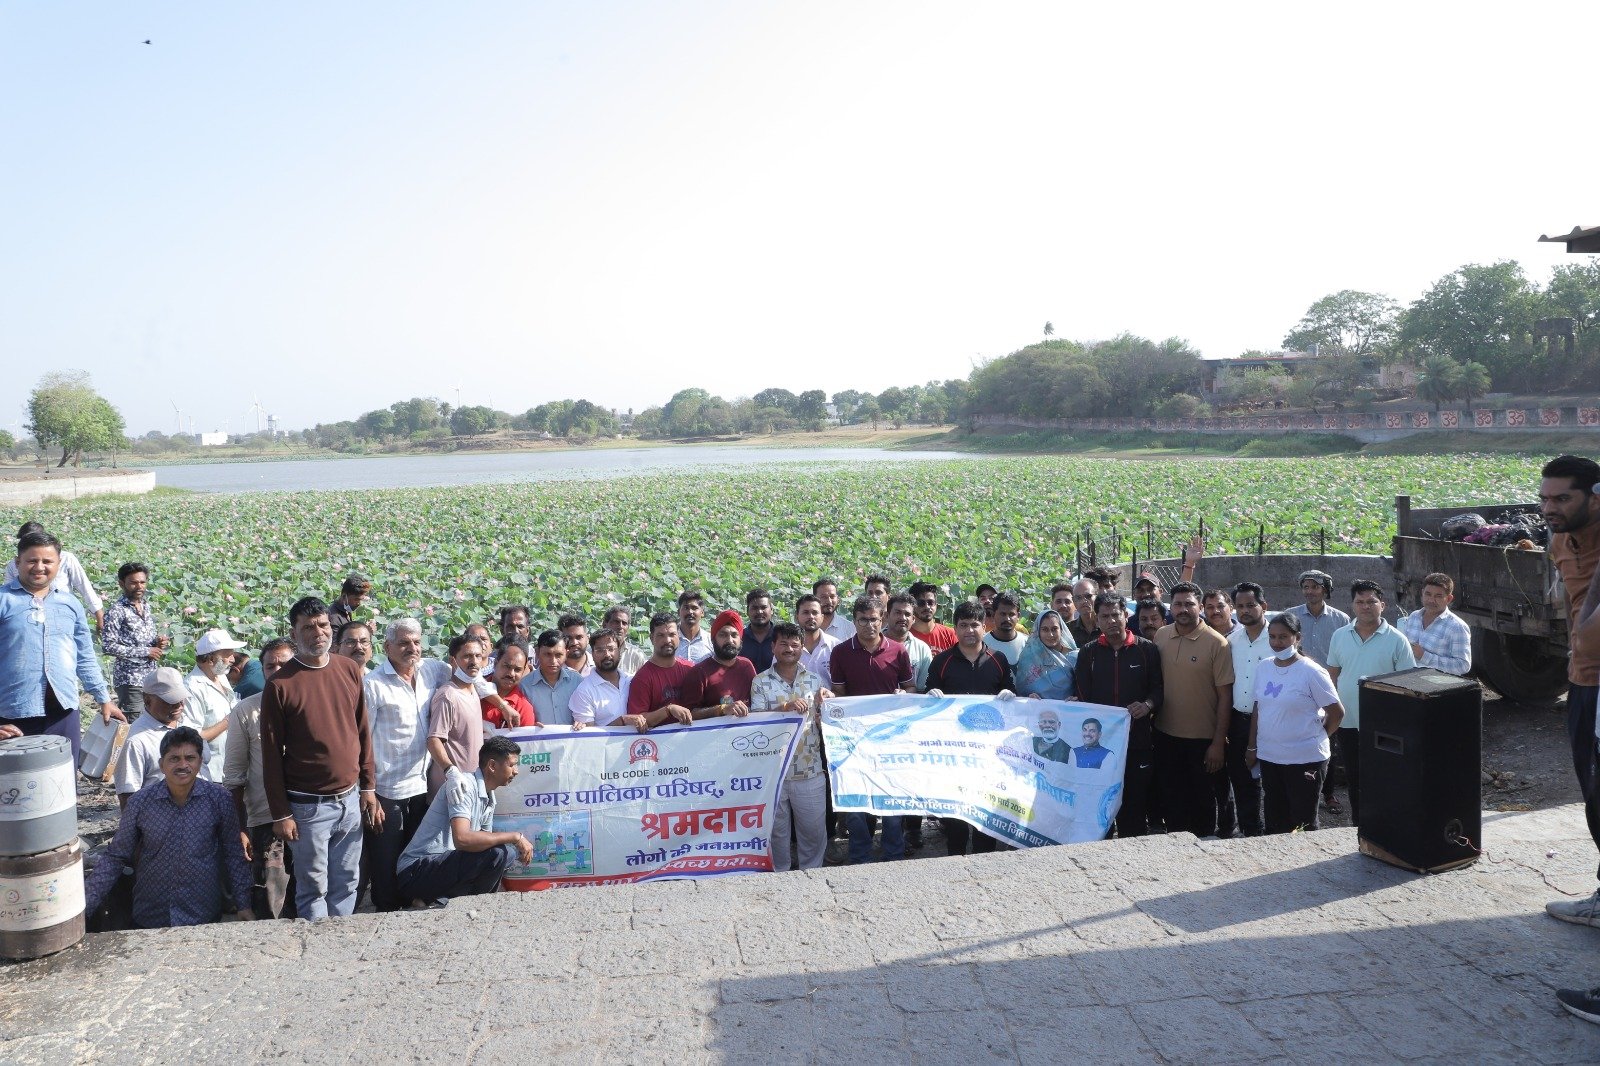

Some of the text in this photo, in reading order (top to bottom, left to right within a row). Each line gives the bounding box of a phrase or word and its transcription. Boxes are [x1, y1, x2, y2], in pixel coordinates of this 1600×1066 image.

[877, 752, 915, 765] जल
[530, 764, 551, 775] 2025
[601, 771, 620, 781] ULB
[622, 769, 649, 779] CODE
[657, 766, 689, 777] 802260
[523, 790, 571, 808] नगर
[576, 783, 651, 805] पालिका
[730, 775, 763, 793] धार
[1010, 802, 1027, 815] 2026
[640, 803, 767, 840] श्रमदान
[992, 816, 1008, 831] धार
[625, 848, 668, 867] लोगो
